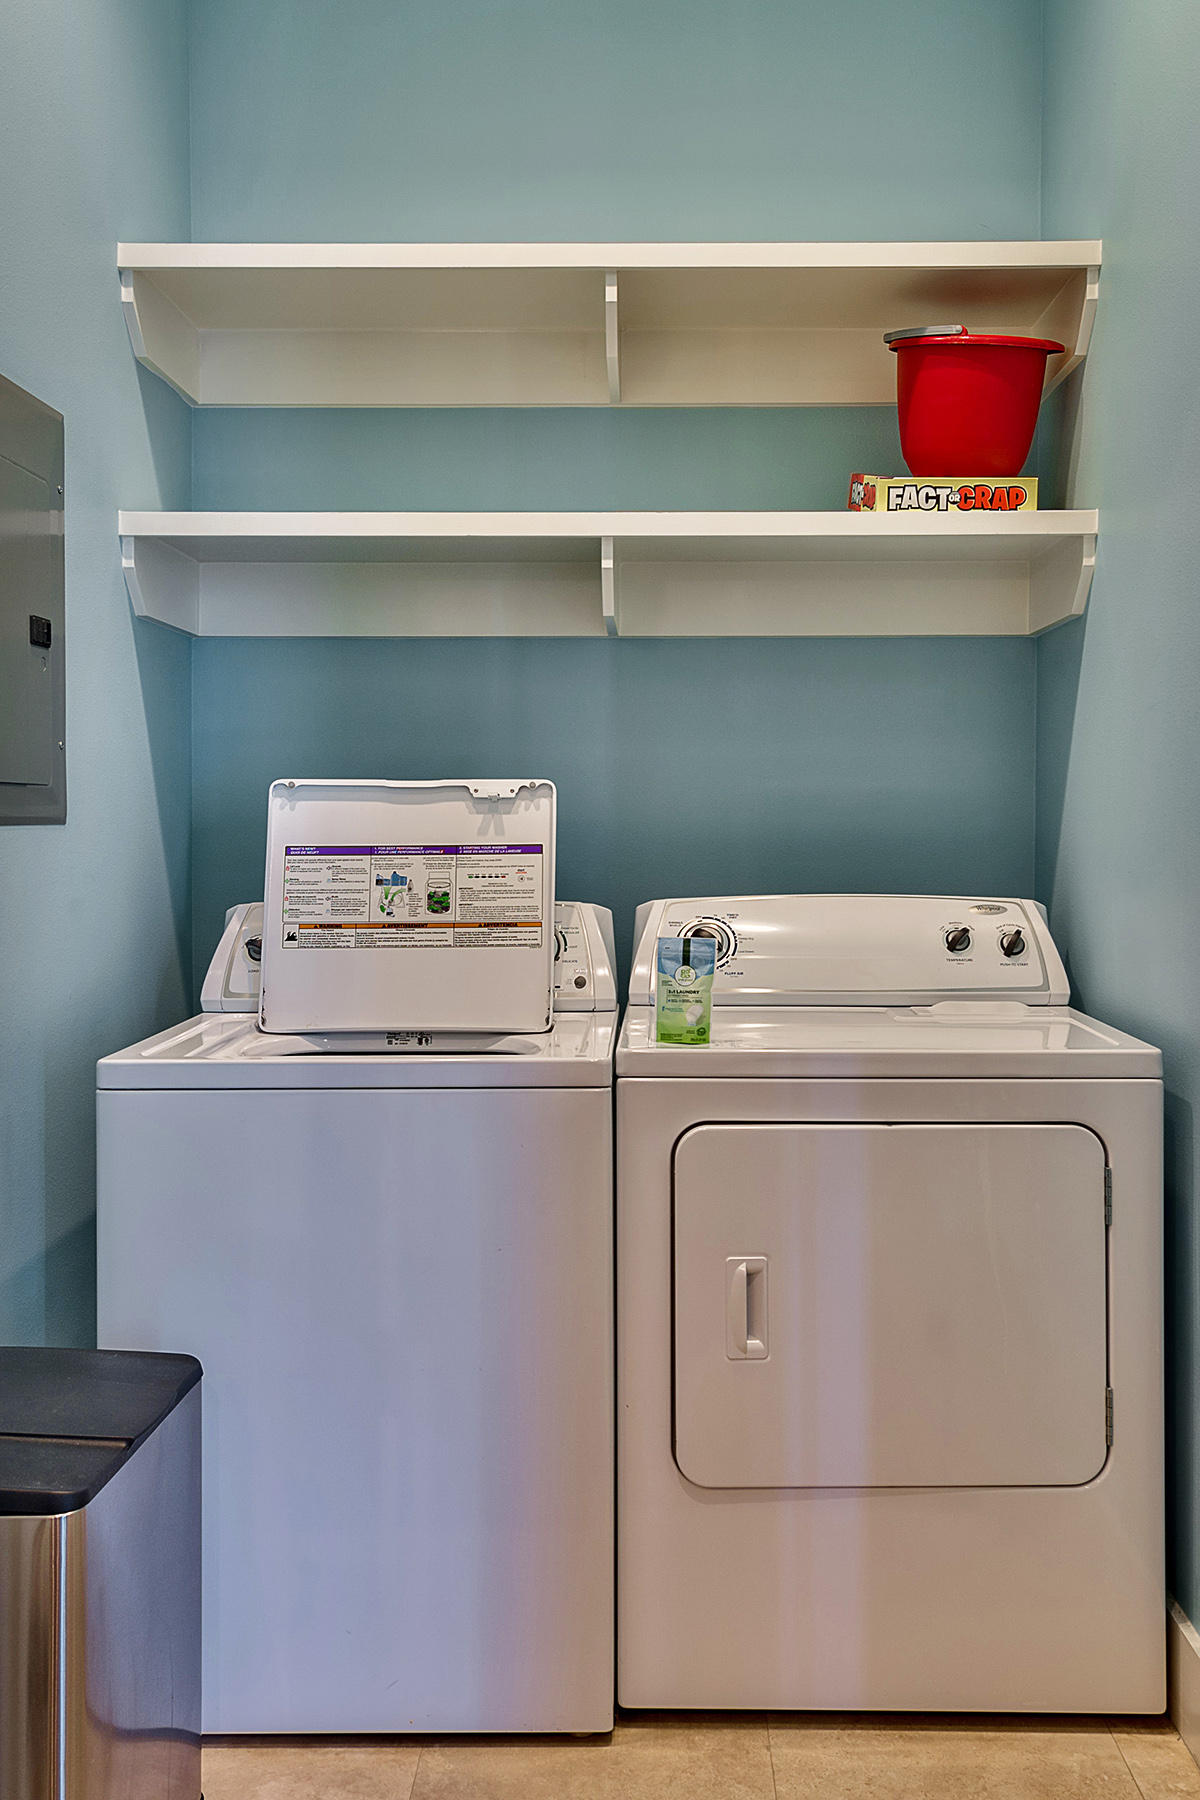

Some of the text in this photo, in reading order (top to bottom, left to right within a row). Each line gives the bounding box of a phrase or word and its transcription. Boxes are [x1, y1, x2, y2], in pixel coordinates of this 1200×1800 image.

[887, 484, 953, 511] FACT
[949, 491, 961, 504] OR
[958, 484, 1028, 511] CRAP
